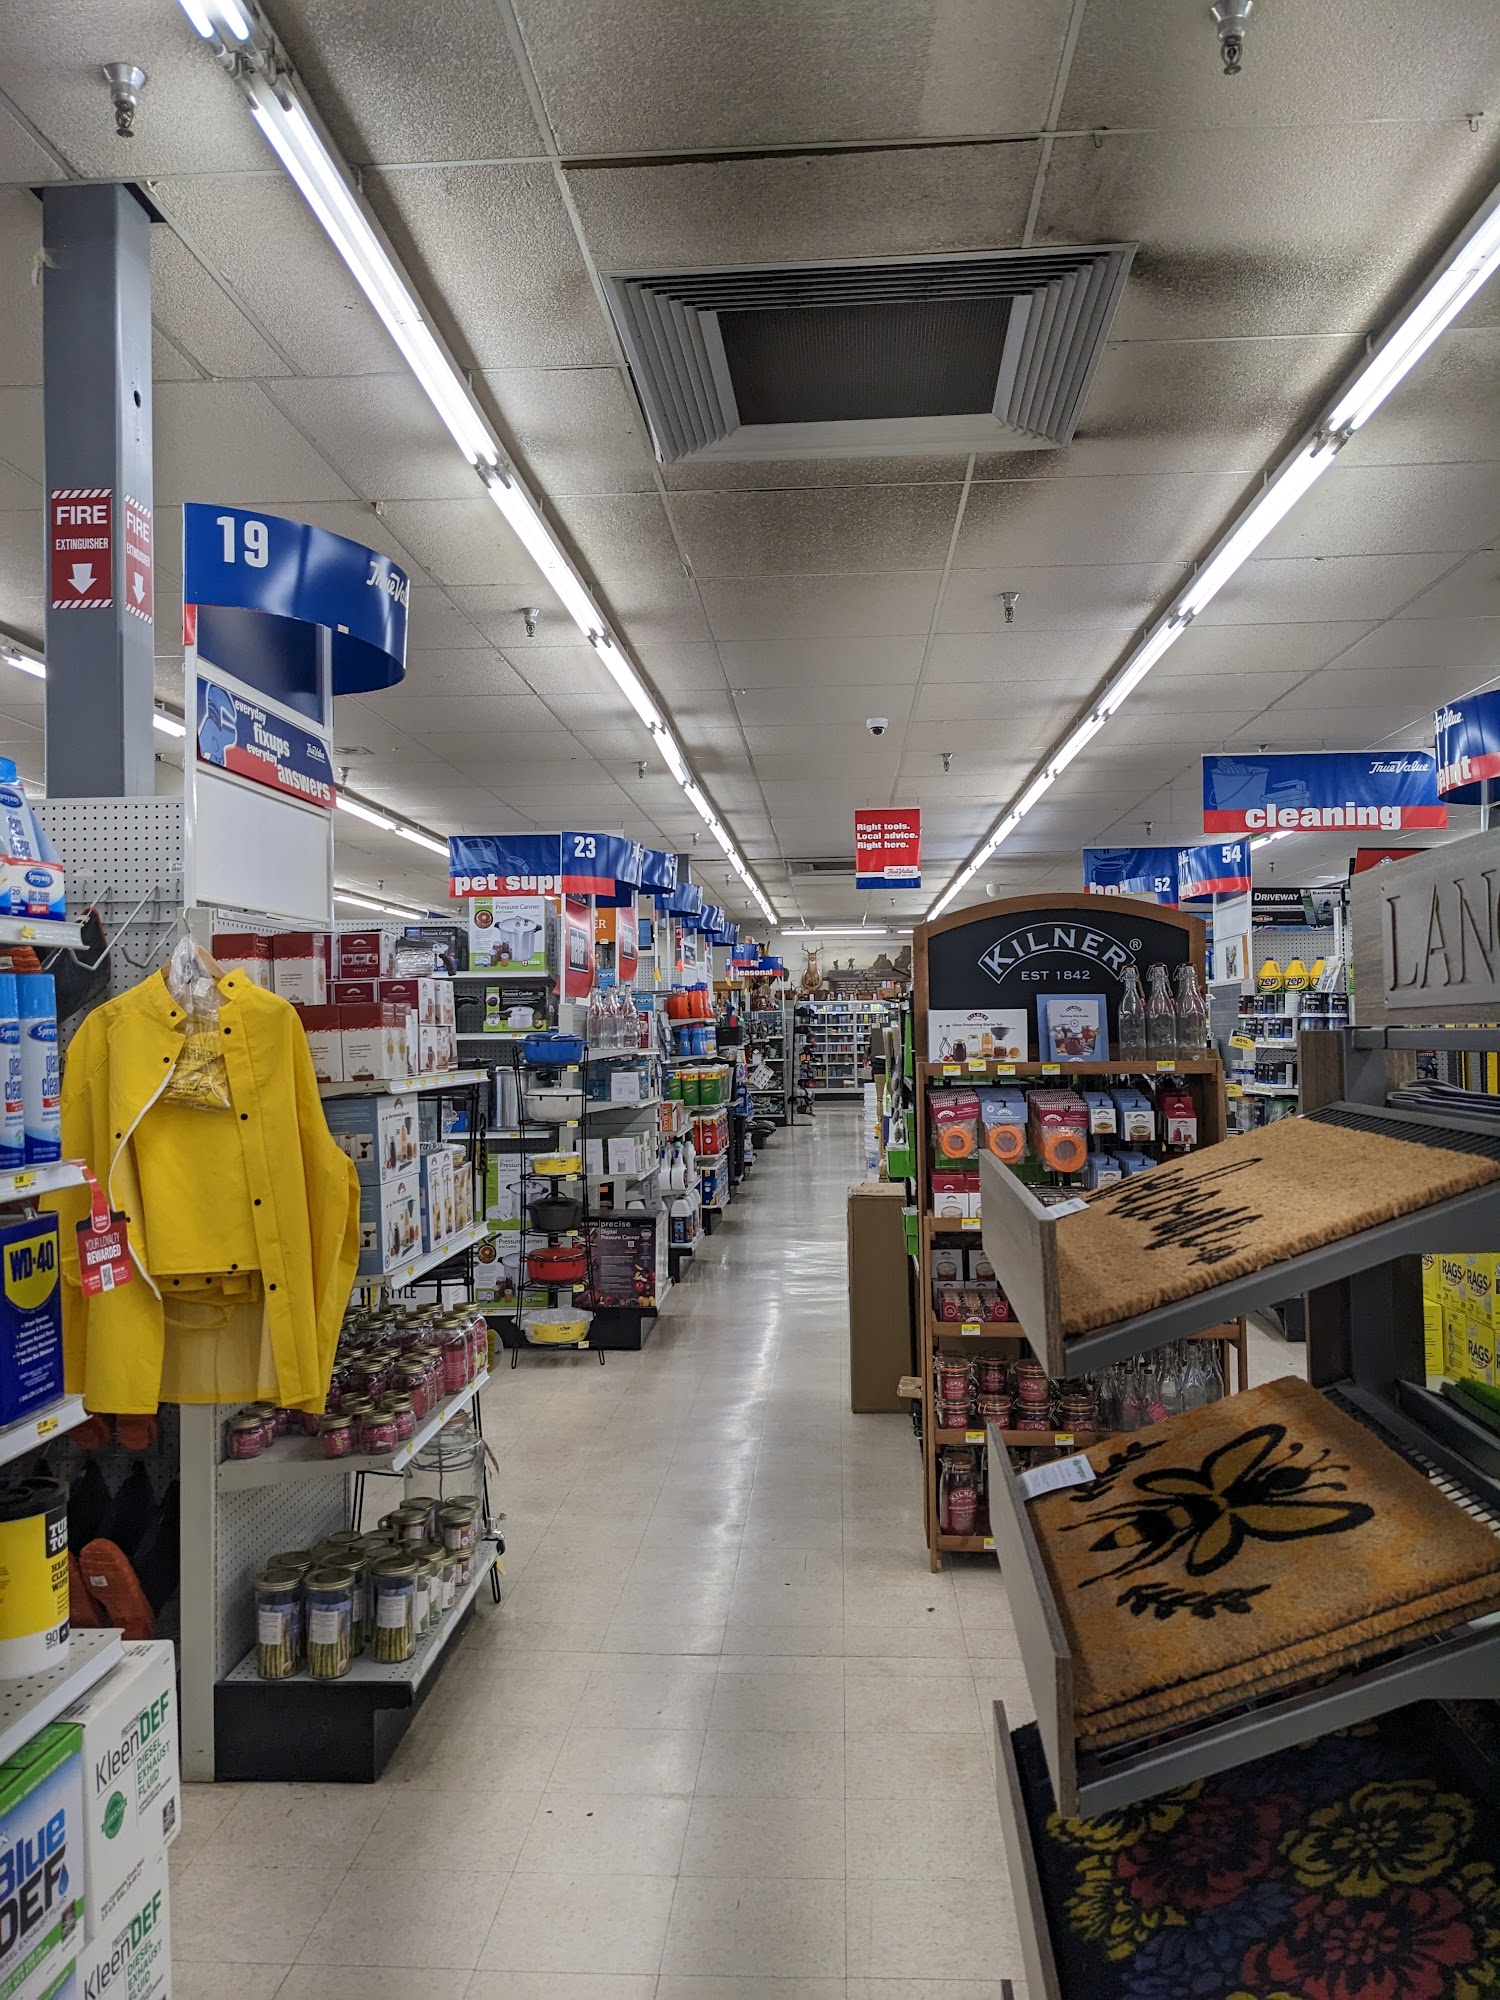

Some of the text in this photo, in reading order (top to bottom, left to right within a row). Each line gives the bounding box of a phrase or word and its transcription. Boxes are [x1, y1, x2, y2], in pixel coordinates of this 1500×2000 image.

[56, 505, 108, 525] FIRE
[126, 510, 150, 543] FIRE
[56, 538, 108, 550] EXTINGUISHER
[216, 516, 269, 568] 19
[234, 700, 266, 726] everyday
[254, 722, 290, 759] fixups
[246, 744, 278, 766] everyday
[1369, 760, 1430, 774] TrueValue
[1437, 755, 1472, 794] aint
[278, 764, 331, 801] answers
[1244, 802, 1402, 830] cleaning
[856, 824, 882, 832] Right
[574, 836, 596, 858] 23
[857, 842, 882, 850] Right
[1222, 845, 1242, 864] 54
[454, 874, 498, 896] pet
[1154, 878, 1170, 892] 52
[1254, 892, 1300, 901] DRIVEWAY
[1387, 868, 1498, 991] LAN
[736, 944, 744, 952] 35
[984, 928, 1127, 975] KILNER
[1021, 970, 1090, 980] EST 1842
[0, 1028, 18, 1040] Spray
[38, 1026, 57, 1038] Spray
[86, 1232, 120, 1251] YOUR LOYALTY
[10, 1240, 54, 1282] WD-40
[86, 1244, 121, 1266] REWARDED
[1442, 1260, 1462, 1278] RAGS
[1467, 1268, 1488, 1291] RAGS
[1468, 1339, 1489, 1364] RAGS
[46, 1630, 58, 1645] 90
[137, 1736, 162, 1770] DIESEL
[137, 1740, 170, 1784] EXHAUST
[138, 1769, 159, 1800] FLUID
[0, 1808, 65, 1902] Blue
[0, 1844, 66, 1960] DEF
[127, 1940, 152, 1975] DIESEL
[128, 1940, 162, 1990] EXHAUST
